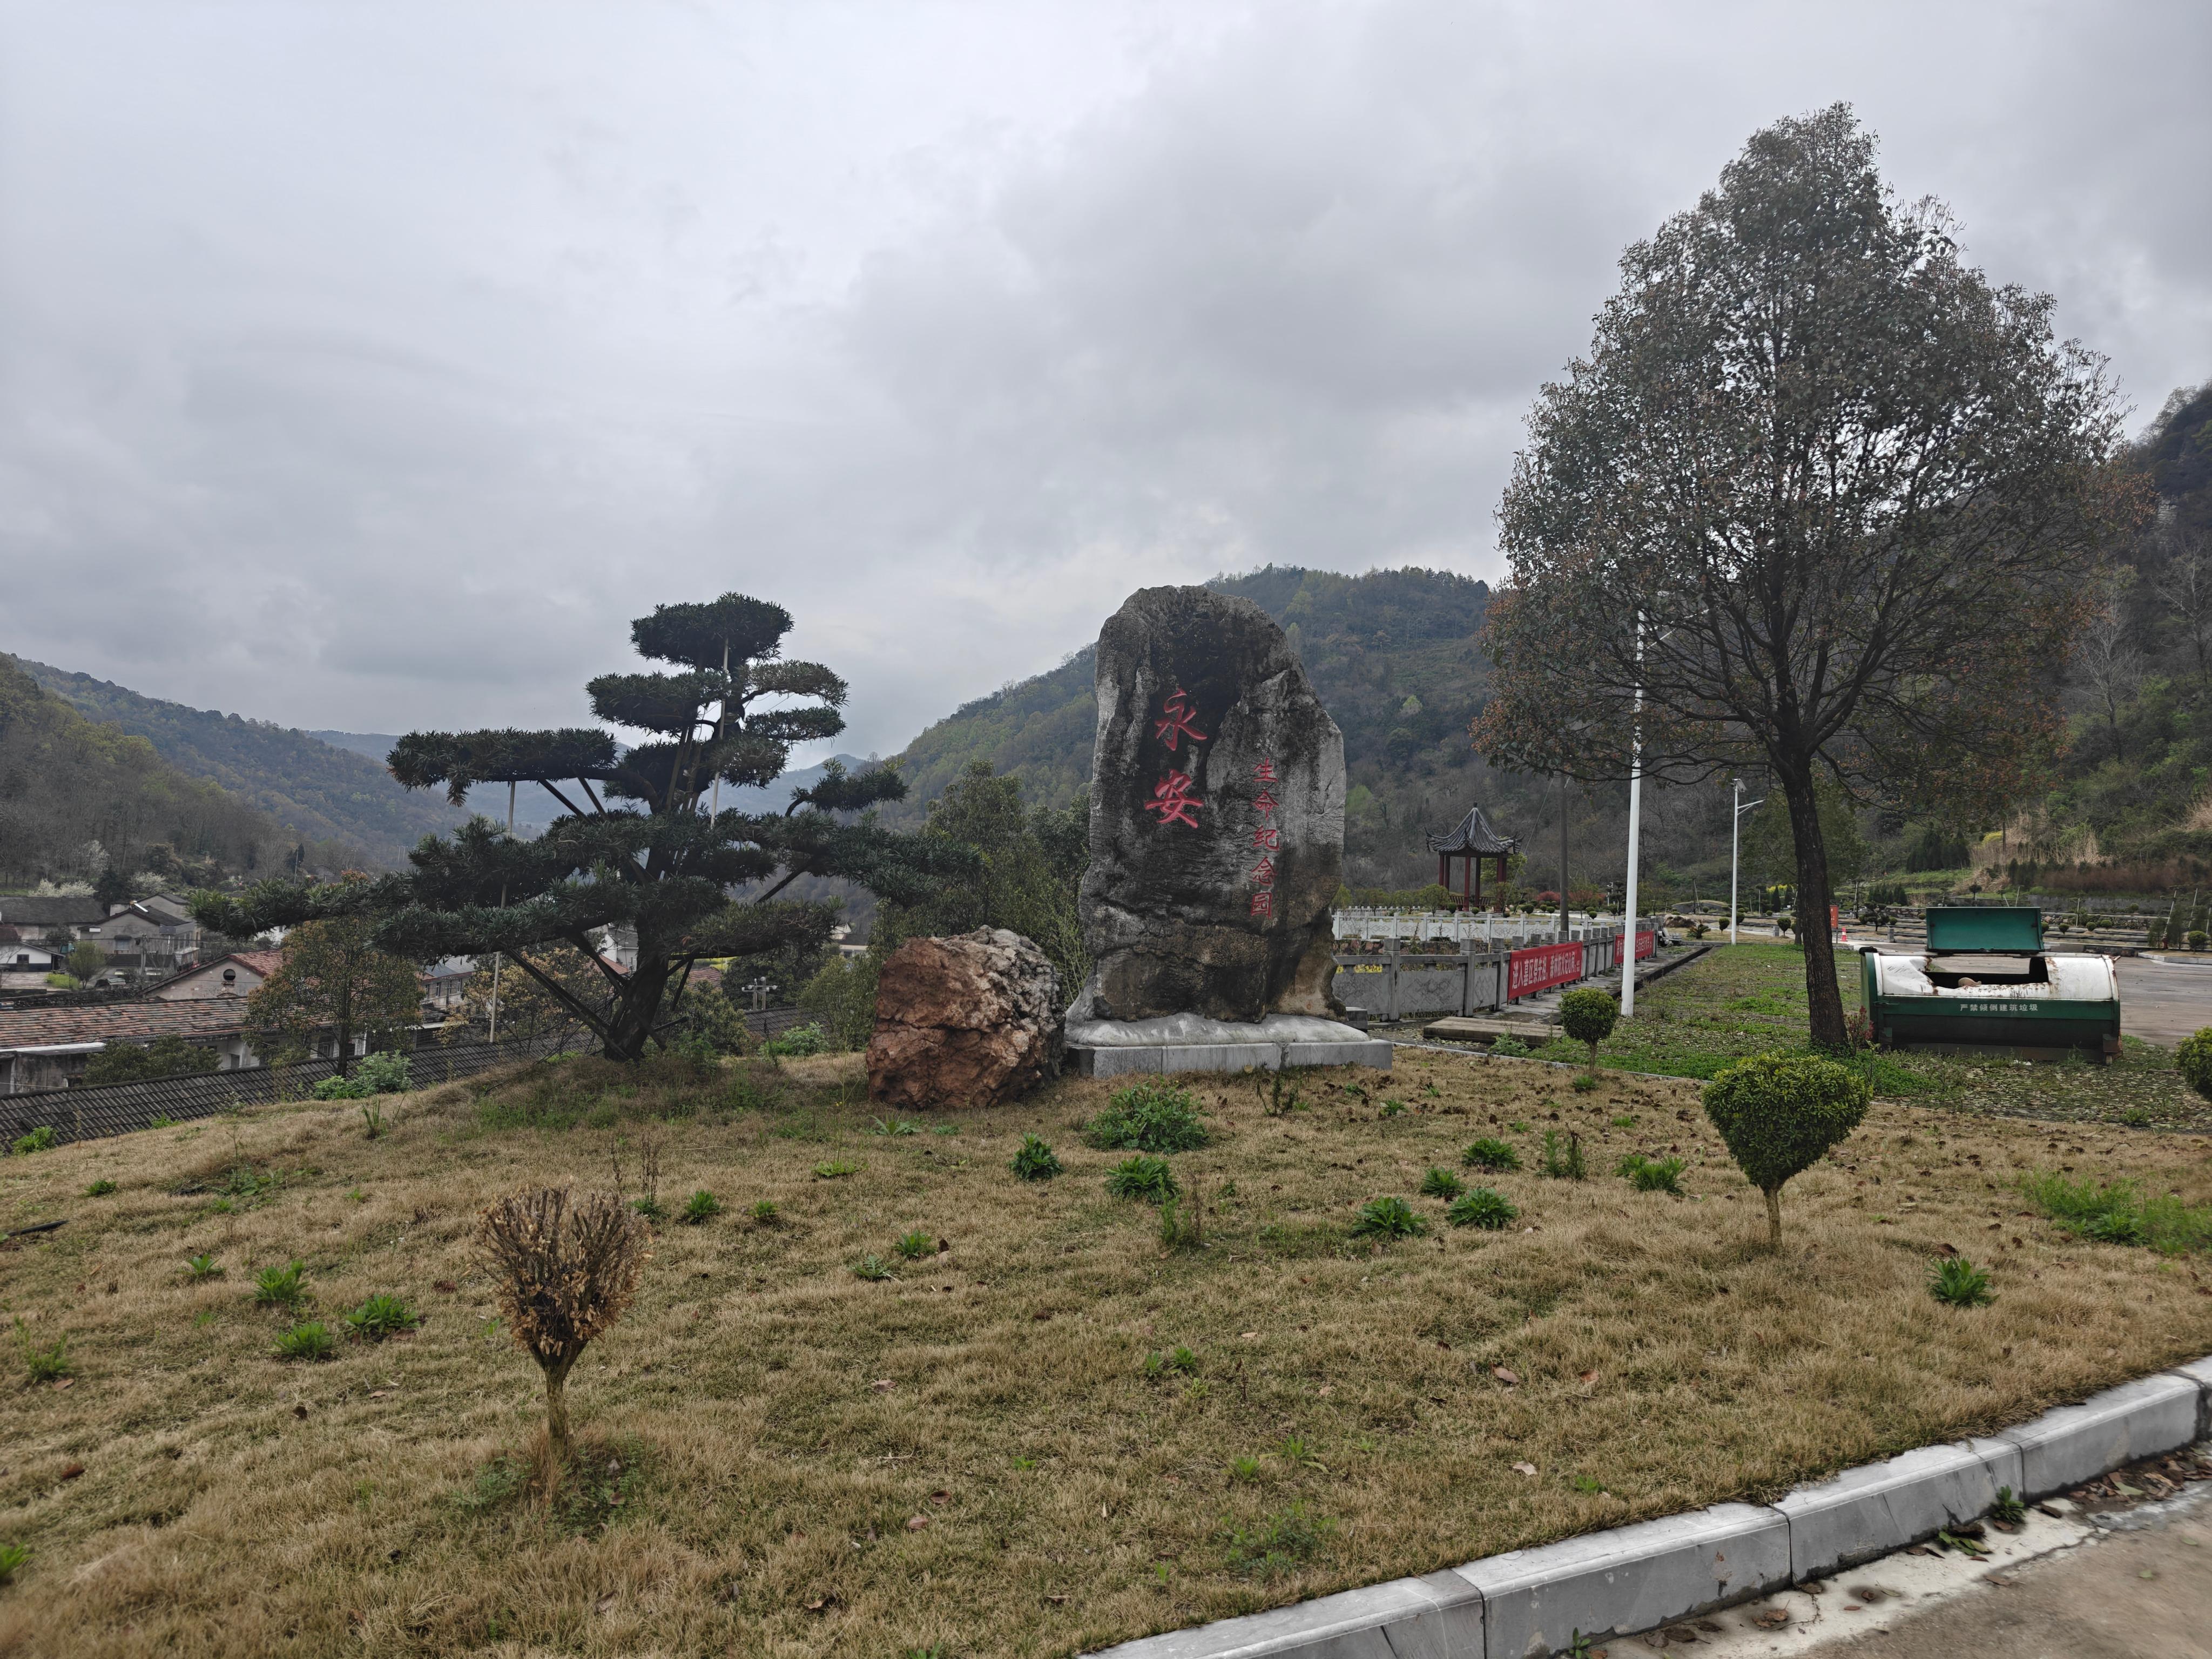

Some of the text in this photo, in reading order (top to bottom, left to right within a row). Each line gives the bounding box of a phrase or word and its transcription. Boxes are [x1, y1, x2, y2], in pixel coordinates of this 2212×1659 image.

[1144, 687, 1208, 828] 永安
[1251, 757, 1280, 919] 生命纪念园
